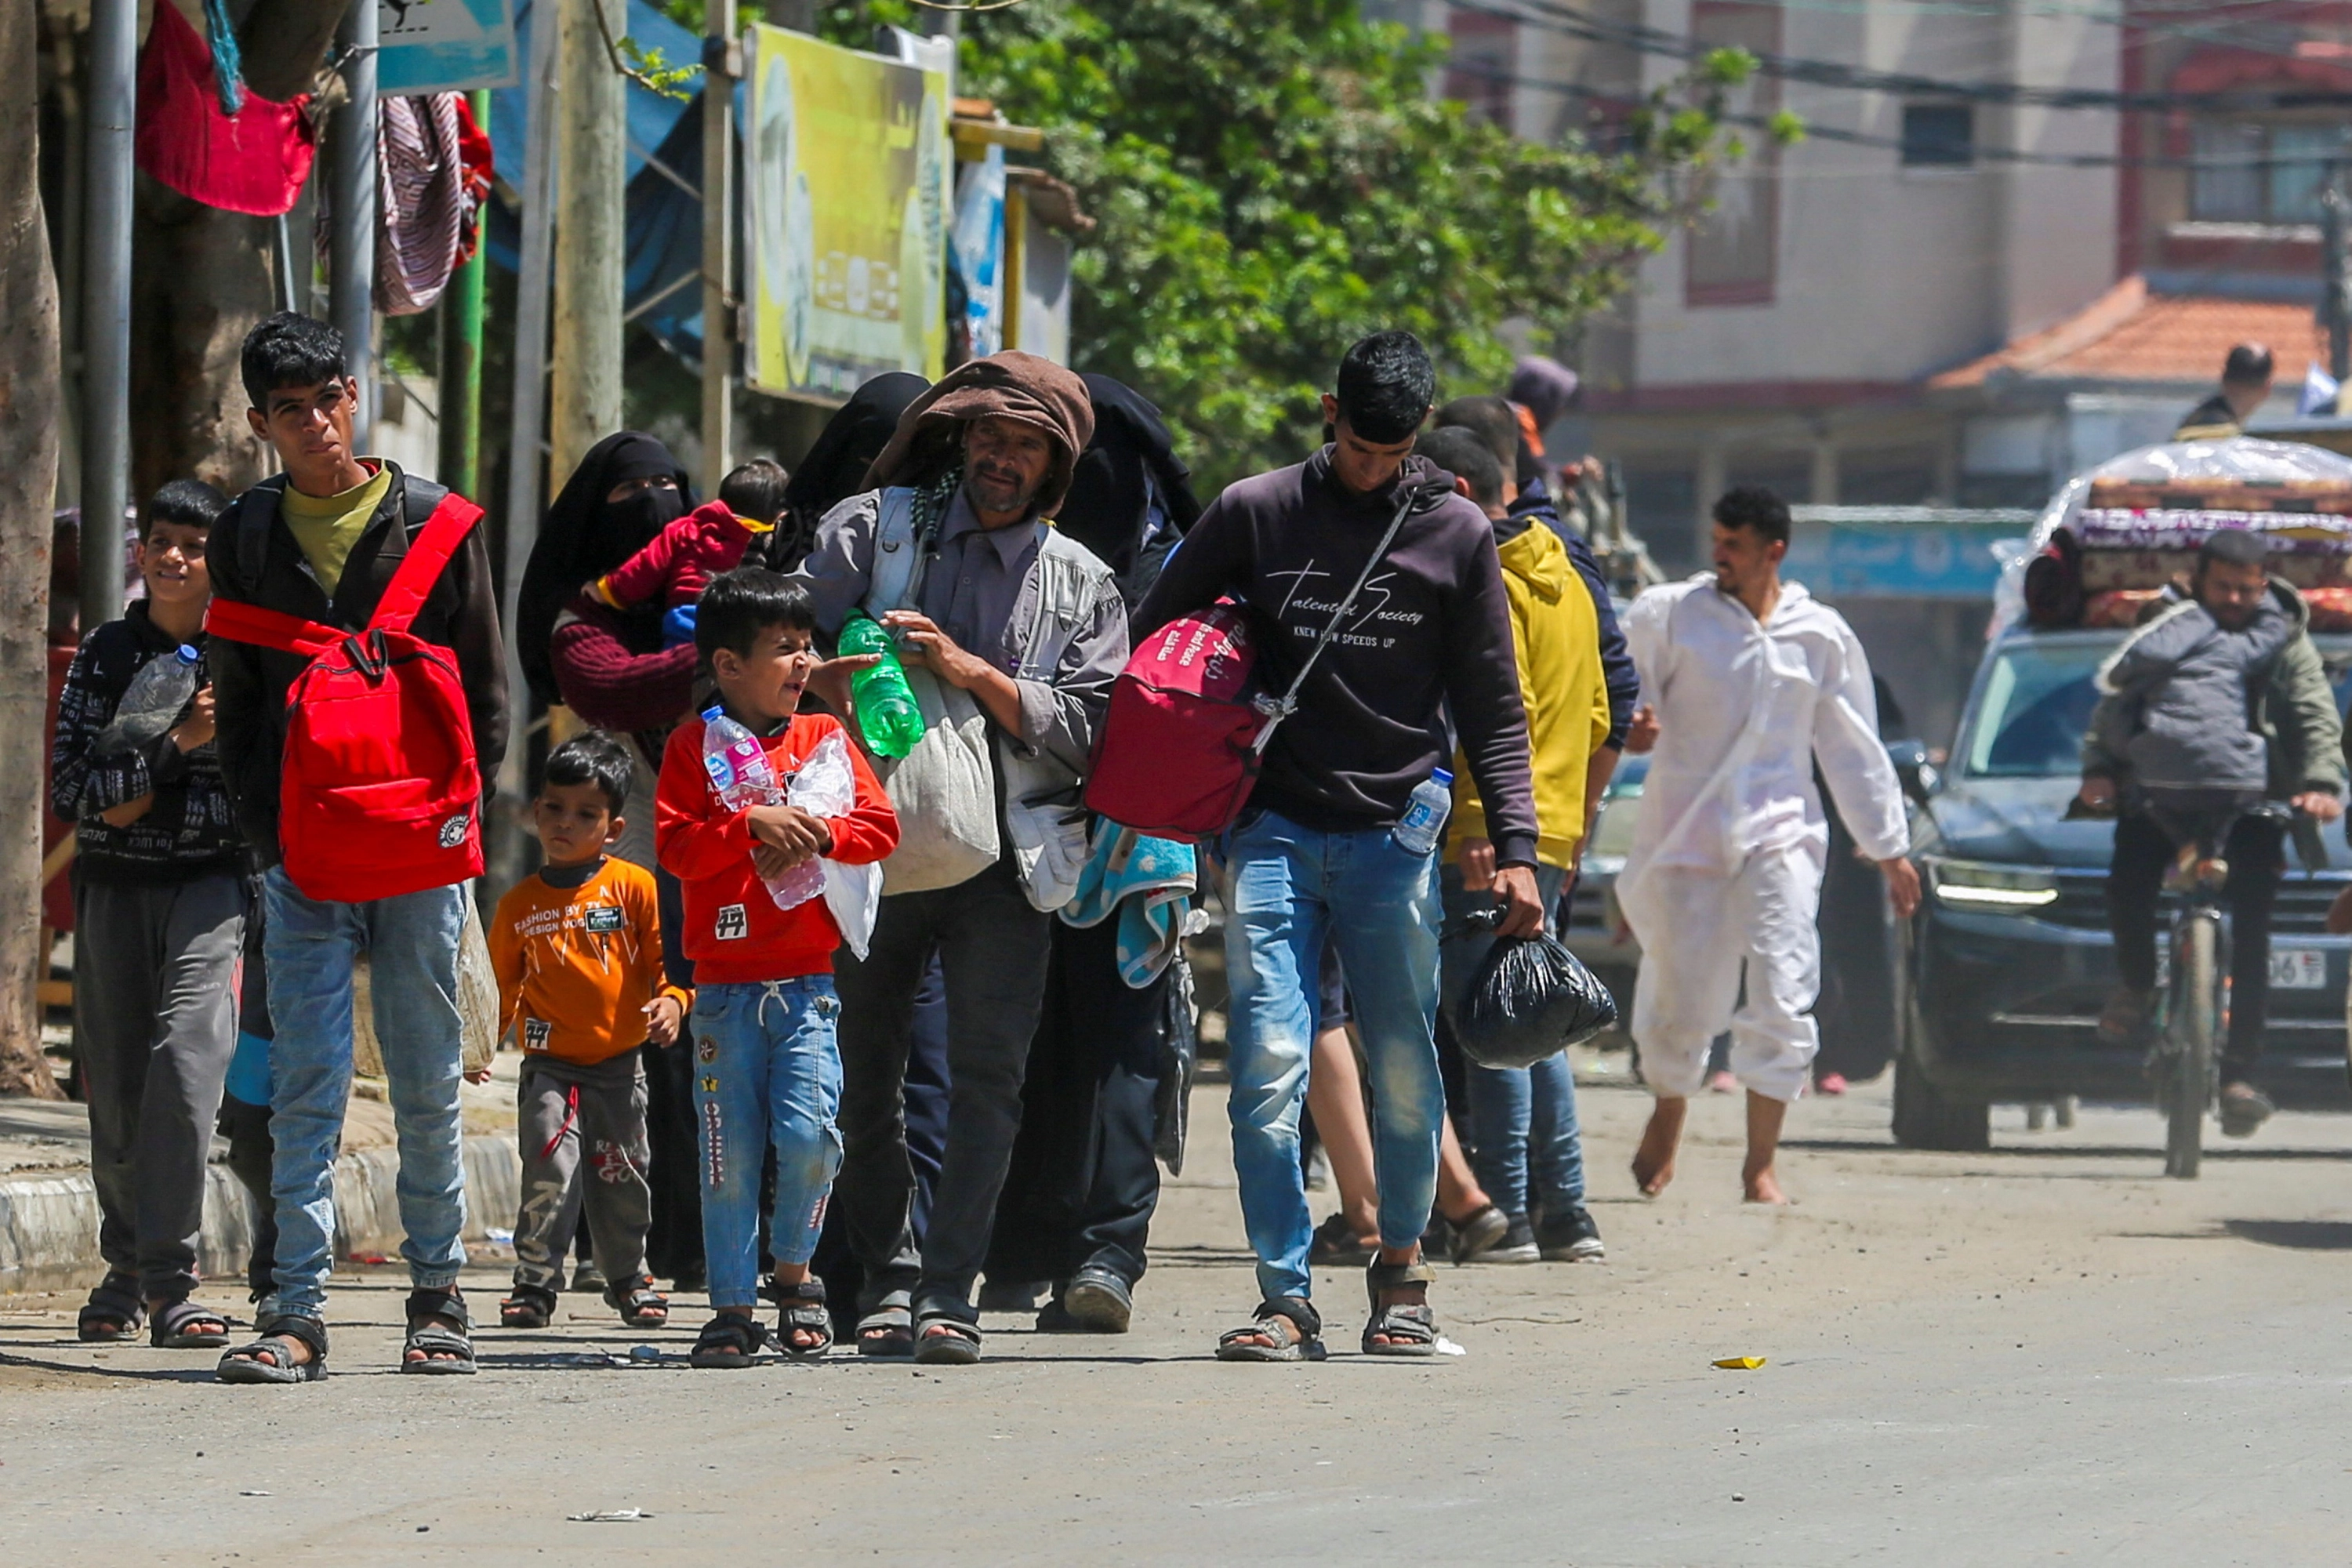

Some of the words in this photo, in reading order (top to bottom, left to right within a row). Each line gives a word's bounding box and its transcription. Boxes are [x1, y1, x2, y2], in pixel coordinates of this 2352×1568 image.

[1191, 630, 1206, 648] and
[1294, 626, 1316, 639] KNEW
[1383, 638, 1396, 648] UP
[1178, 643, 1201, 666] Peace
[514, 908, 560, 934] FASHION
[564, 902, 581, 916] BY
[524, 922, 559, 938] DESIGN
[563, 918, 586, 930] VOG
